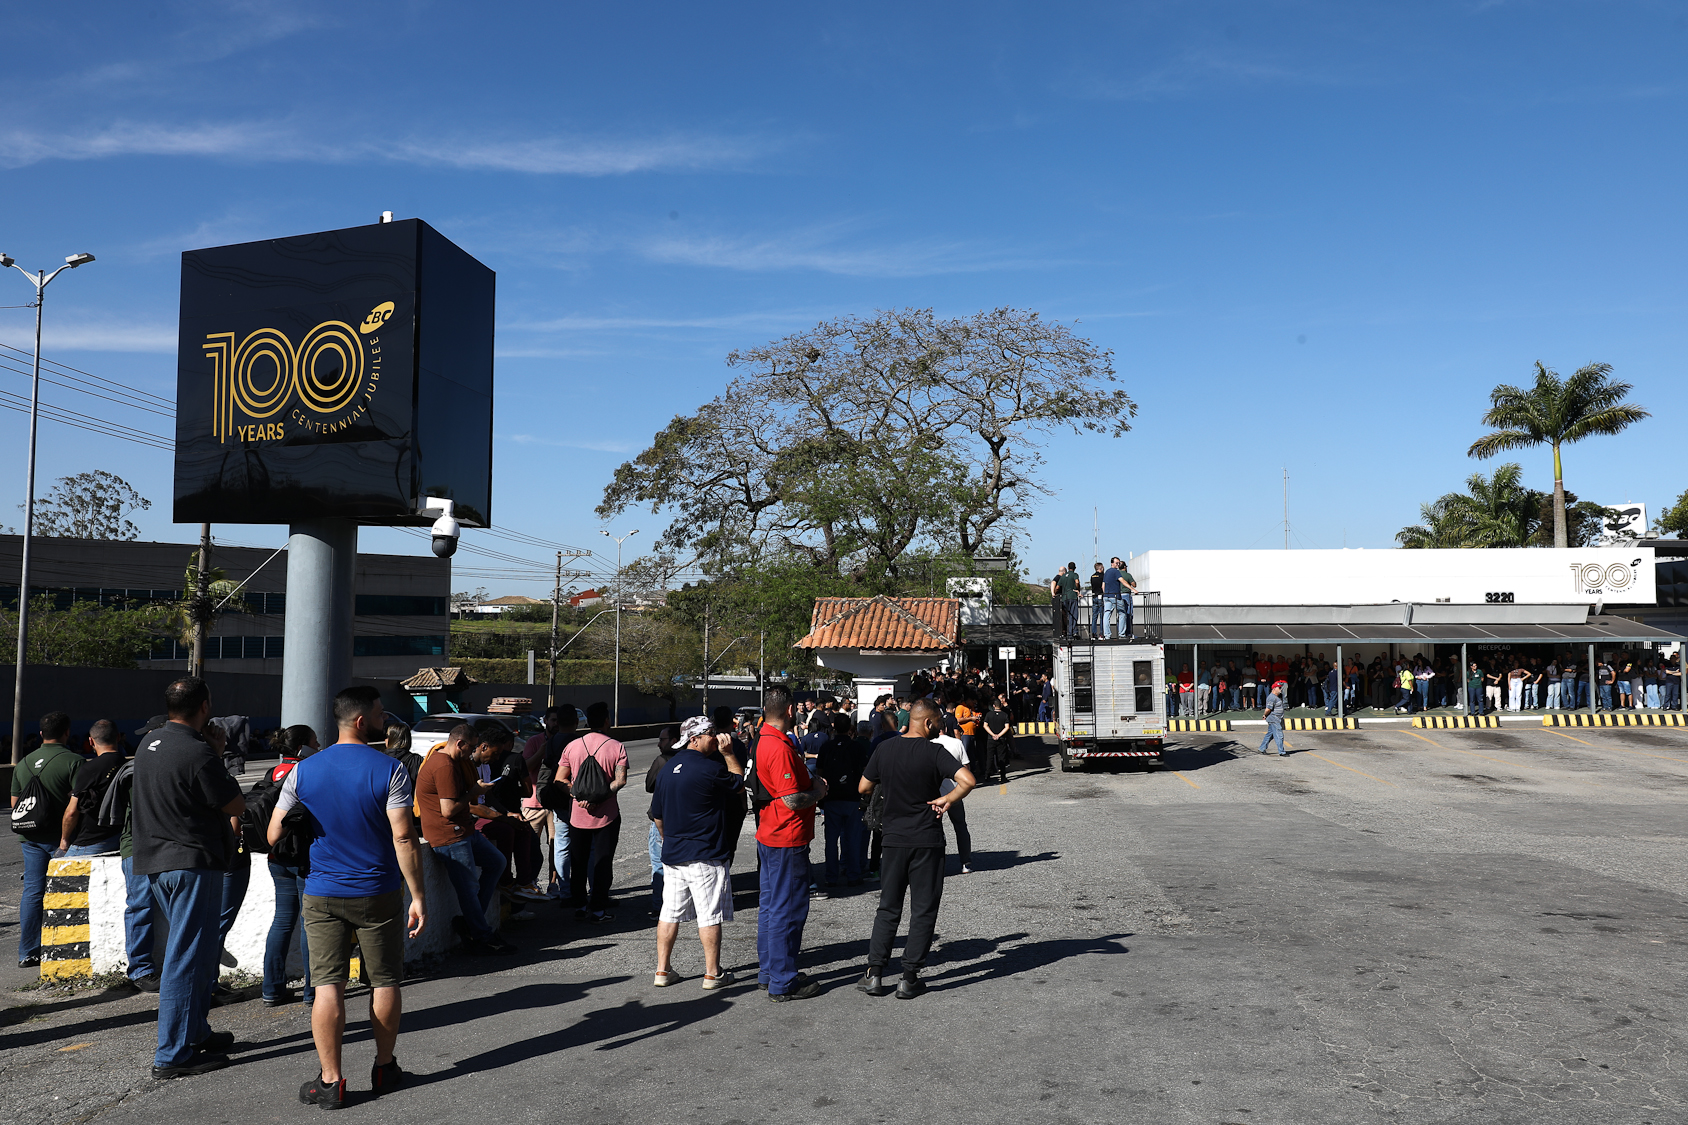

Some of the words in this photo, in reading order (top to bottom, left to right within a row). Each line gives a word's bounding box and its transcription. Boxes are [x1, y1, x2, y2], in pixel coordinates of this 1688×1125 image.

[361, 307, 393, 327] CBC
[202, 320, 364, 443] 100
[292, 405, 366, 434] CENTENNIAL
[364, 337, 382, 401] JUBILEE
[237, 422, 285, 442] YEARS
[1569, 563, 1631, 594] 100
[1485, 592, 1514, 603] 3220
